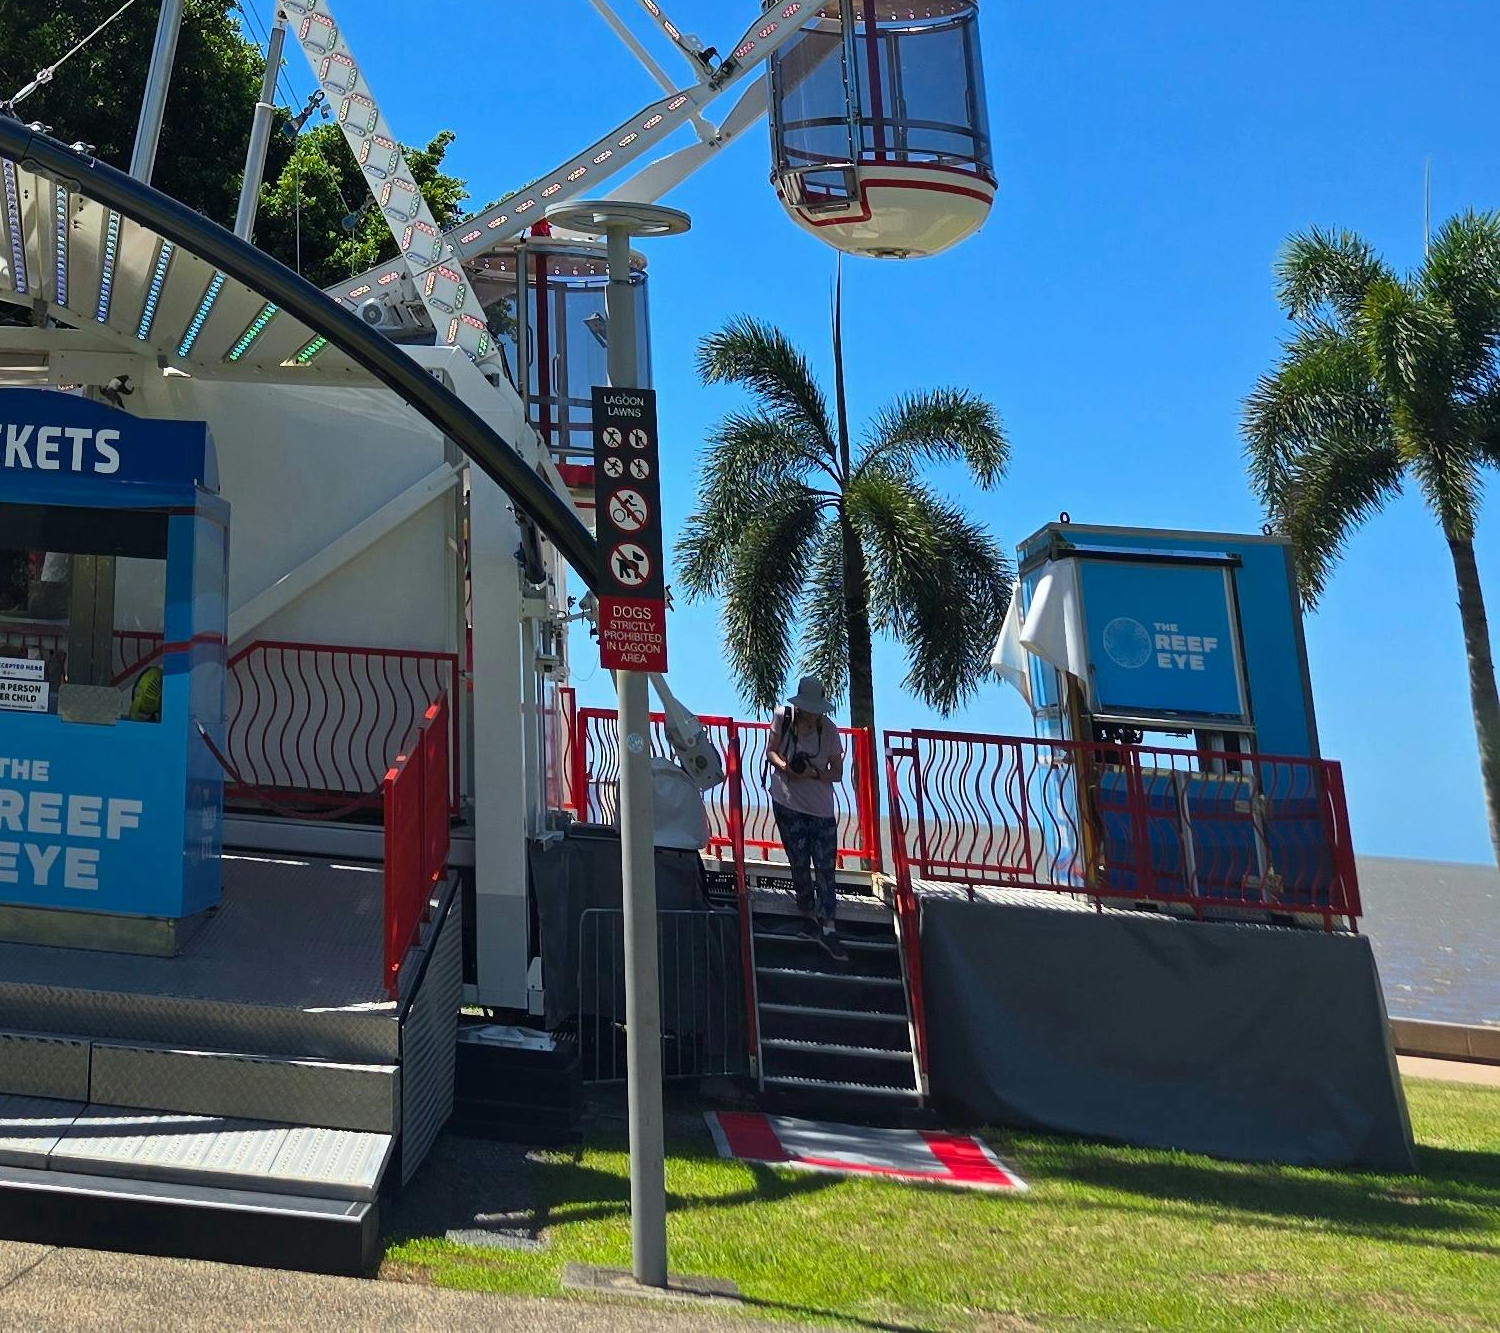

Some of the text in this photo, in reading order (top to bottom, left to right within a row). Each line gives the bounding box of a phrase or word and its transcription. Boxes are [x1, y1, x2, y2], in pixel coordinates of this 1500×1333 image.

[603, 395, 644, 406] LAGOON
[607, 406, 641, 418] LAWNS
[613, 605, 652, 619] DOGS
[610, 620, 656, 632] STRICTLY
[1153, 622, 1179, 632] THE
[604, 630, 662, 643] PROHIBITED
[606, 641, 661, 654] IN LAGOON
[1155, 634, 1219, 653] REEF
[620, 652, 648, 664] AREA
[1157, 652, 1205, 671] EYE
[25, 664, 43, 672] HERE
[7, 682, 42, 694] PERSON
[11, 693, 37, 703] CHILD
